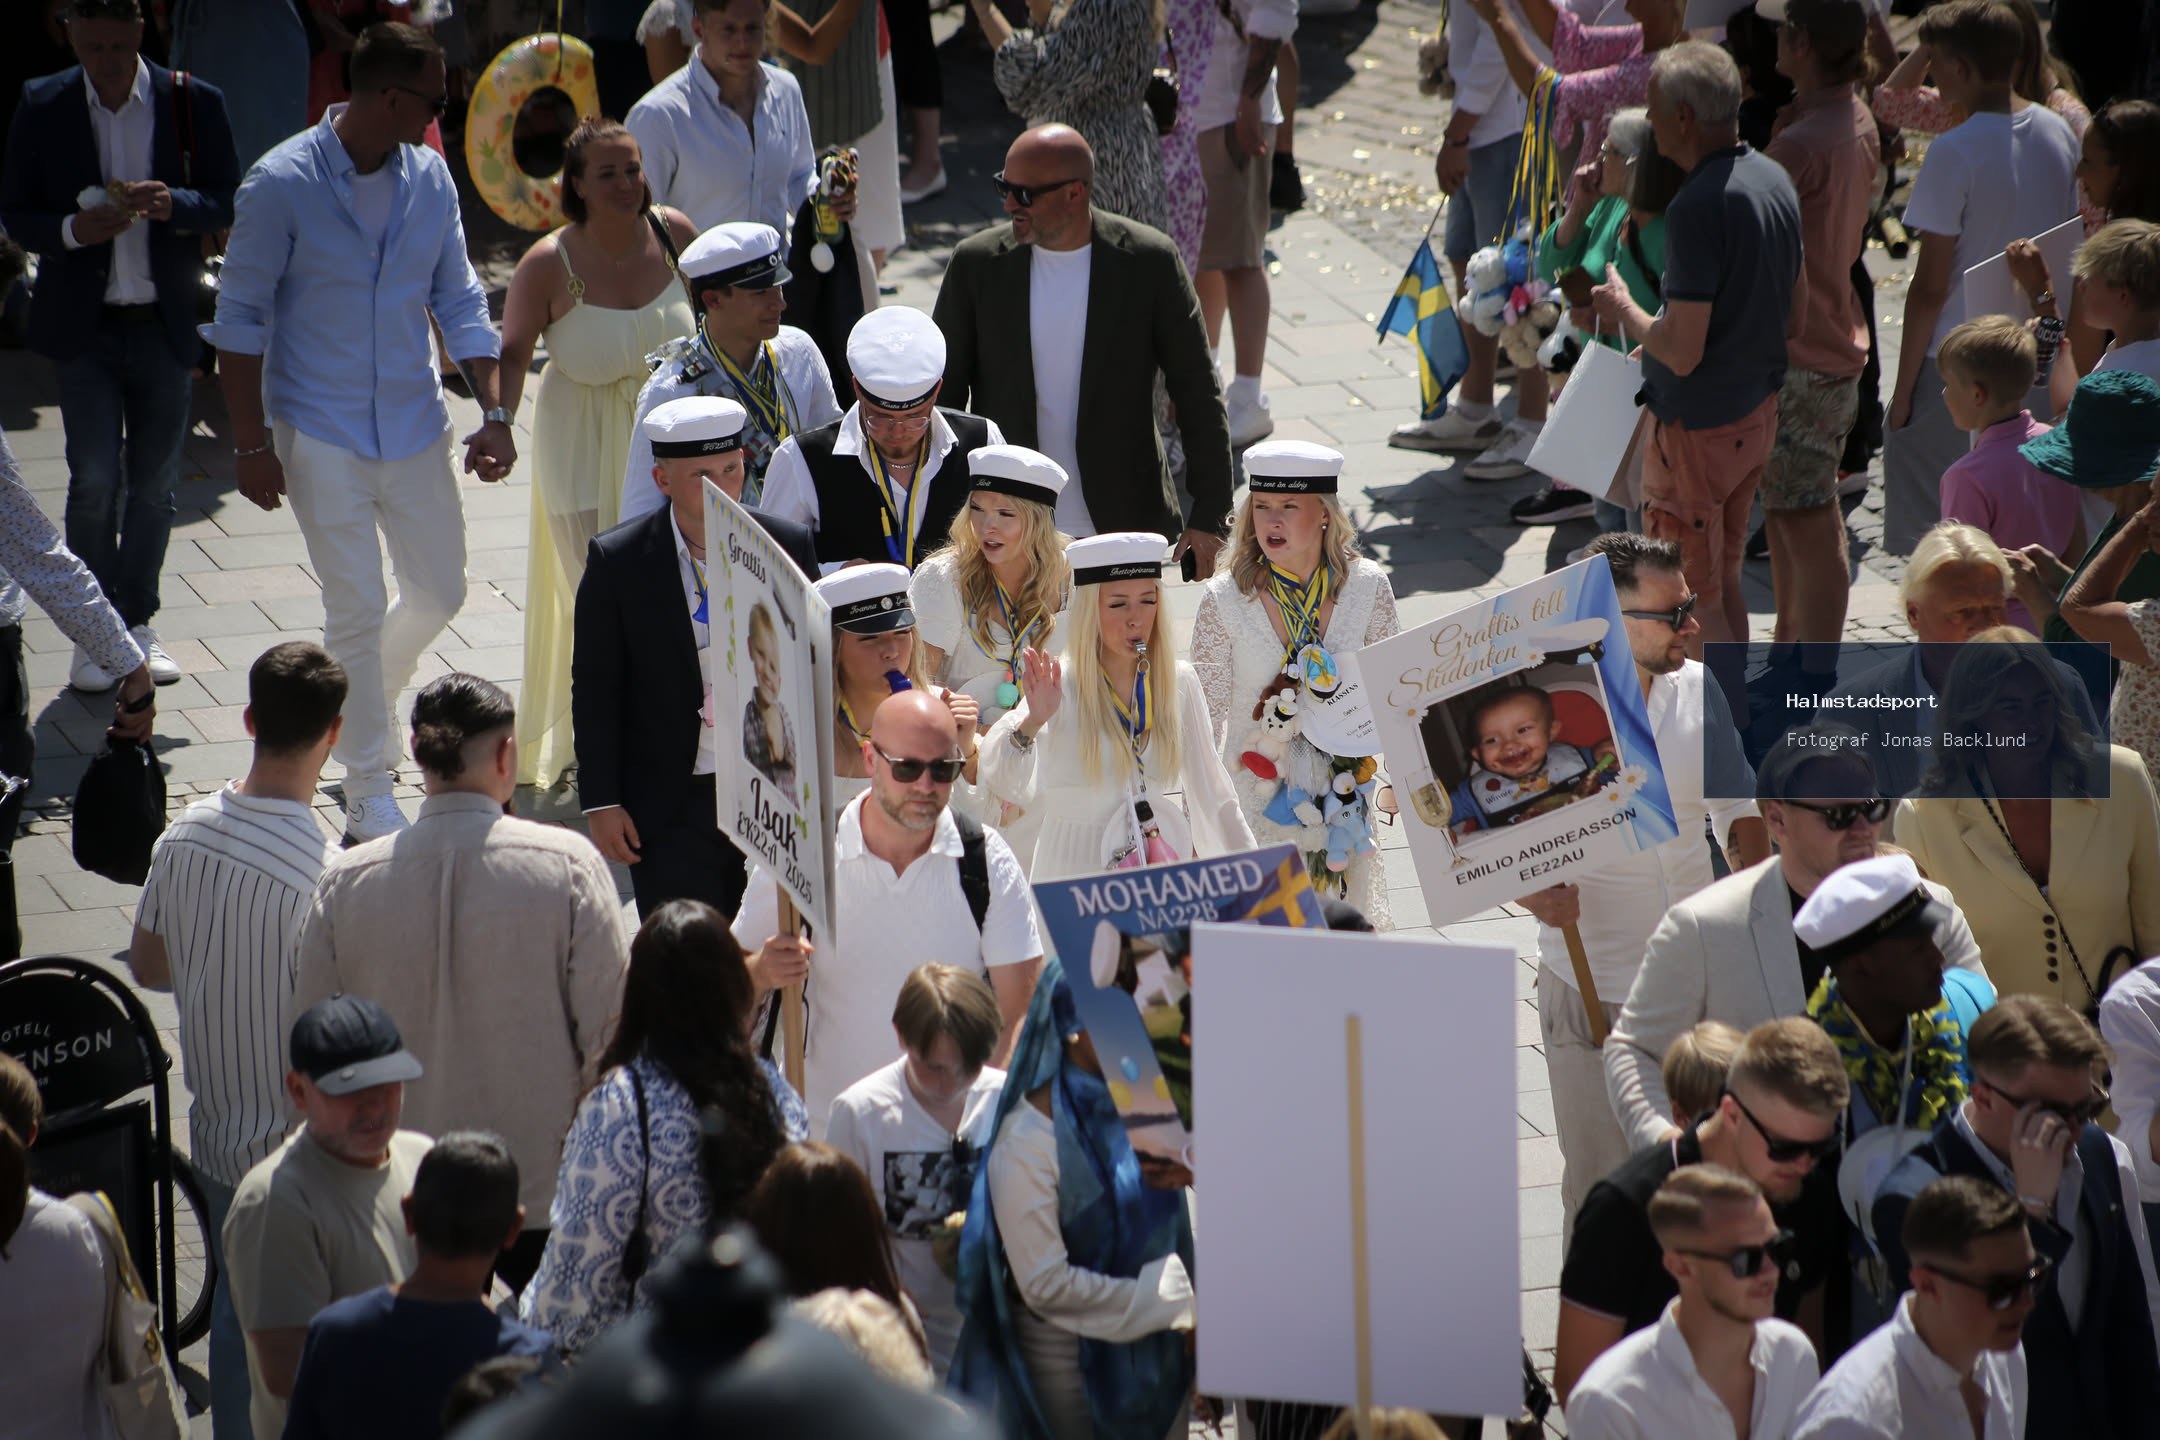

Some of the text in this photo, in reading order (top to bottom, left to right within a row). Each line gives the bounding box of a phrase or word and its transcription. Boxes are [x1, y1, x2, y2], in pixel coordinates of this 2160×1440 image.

[1288, 480, 1308, 490] aldrig
[729, 532, 766, 585] Grattis
[1430, 586, 1568, 662] Grattis till
[1327, 683, 1359, 707] KLASSENS
[1387, 644, 1519, 708] Studenten
[750, 777, 798, 862] Isak
[1456, 807, 1638, 886] EMILIO ANDREASSON
[1519, 848, 1585, 882] EE22AU
[785, 857, 812, 904] 2025
[1069, 859, 1264, 918] MOHAMED
[1137, 901, 1219, 932] NA22B
